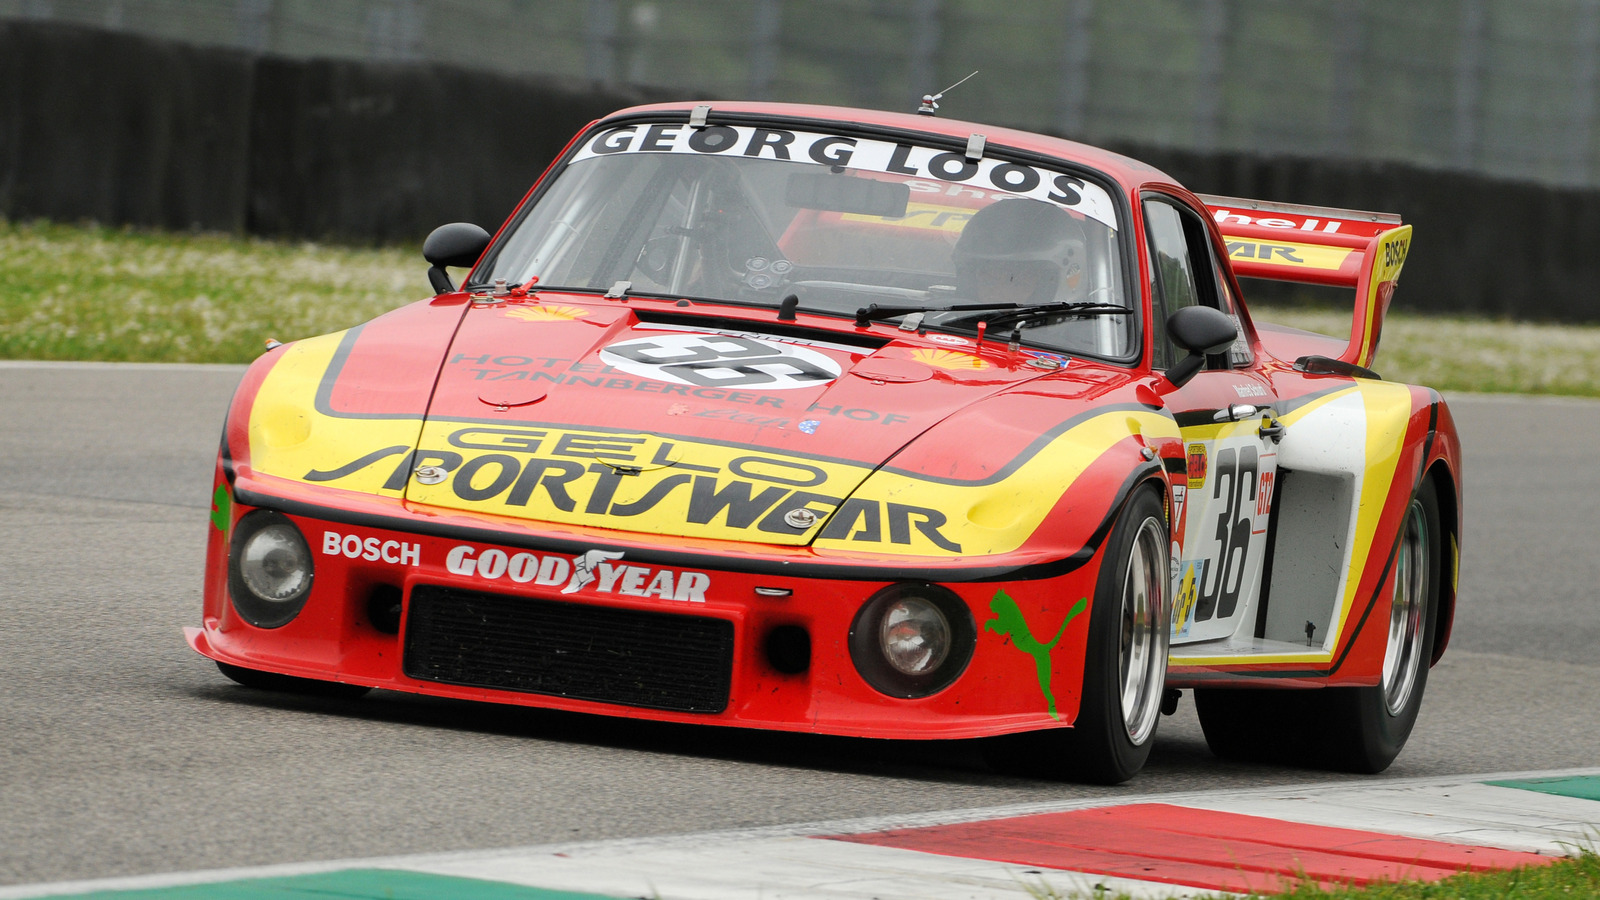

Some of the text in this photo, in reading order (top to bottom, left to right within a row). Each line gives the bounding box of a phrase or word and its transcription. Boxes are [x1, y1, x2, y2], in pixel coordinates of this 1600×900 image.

[591, 125, 858, 167] GEORG
[886, 143, 1085, 206] LOOS
[1214, 209, 1342, 233] hell
[450, 353, 628, 375] HOTEL
[603, 336, 838, 387] 36
[469, 368, 786, 409] TANNBERGER
[807, 402, 911, 425] HOF
[448, 427, 828, 487] GELO
[303, 445, 962, 553] SPORTSWEAR
[1256, 472, 1274, 517] GT2
[322, 531, 421, 567] BOSCH
[1194, 445, 1258, 623] 36
